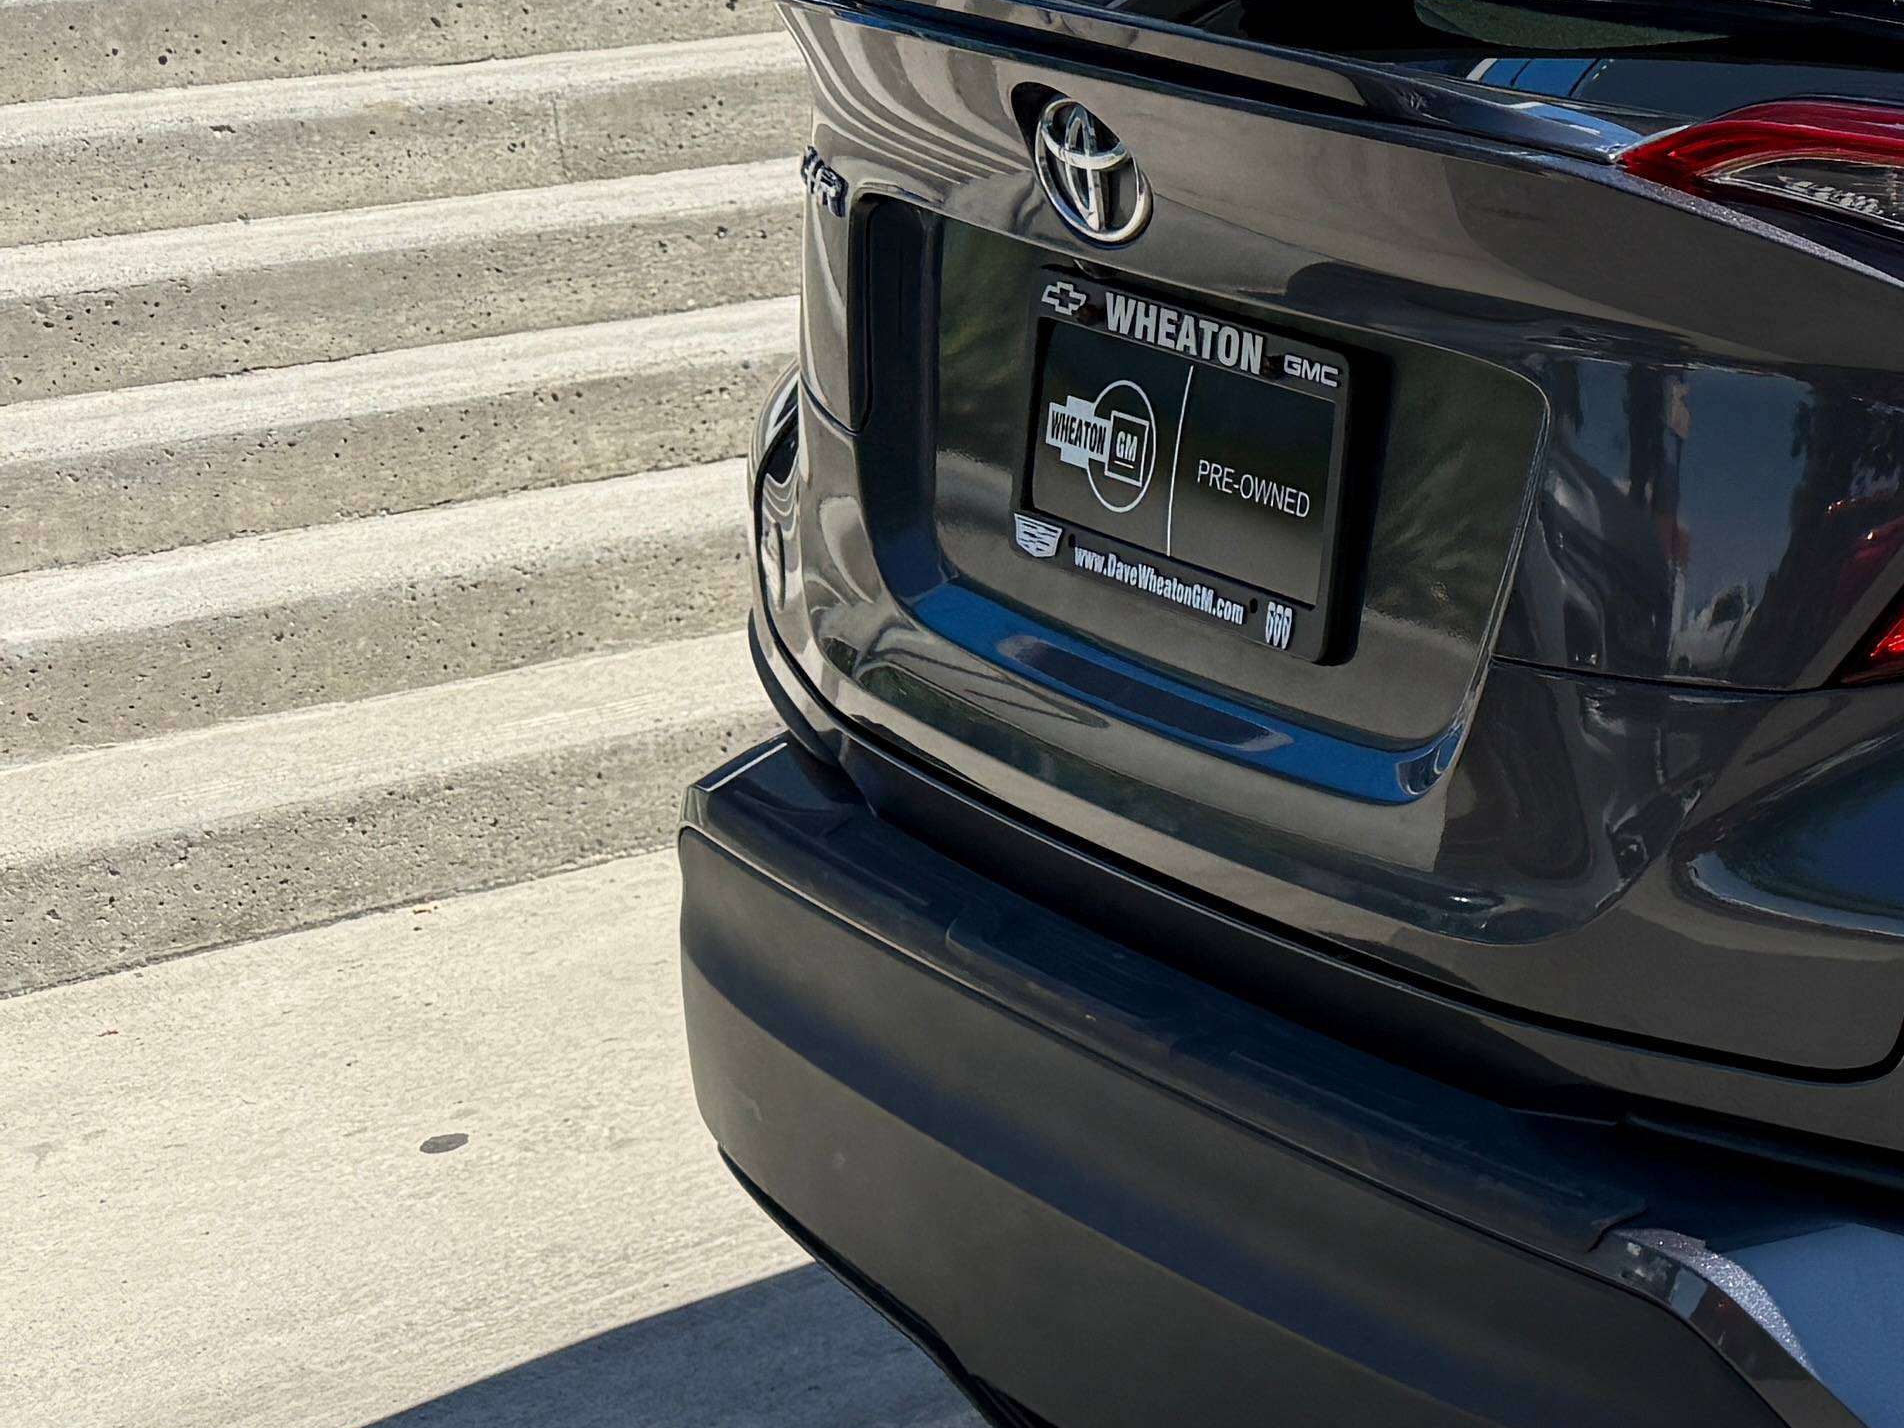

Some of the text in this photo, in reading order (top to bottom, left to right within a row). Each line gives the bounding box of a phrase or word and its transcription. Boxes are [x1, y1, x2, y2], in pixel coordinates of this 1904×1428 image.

[1105, 291, 1264, 375] WHEATON
[1283, 354, 1340, 388] GMC
[1051, 409, 1107, 456] WHEATON
[1115, 430, 1138, 463] GM
[1197, 459, 1311, 519] PRE-OWNED
[1073, 546, 1245, 626] www.DaveWheatonGM.com
